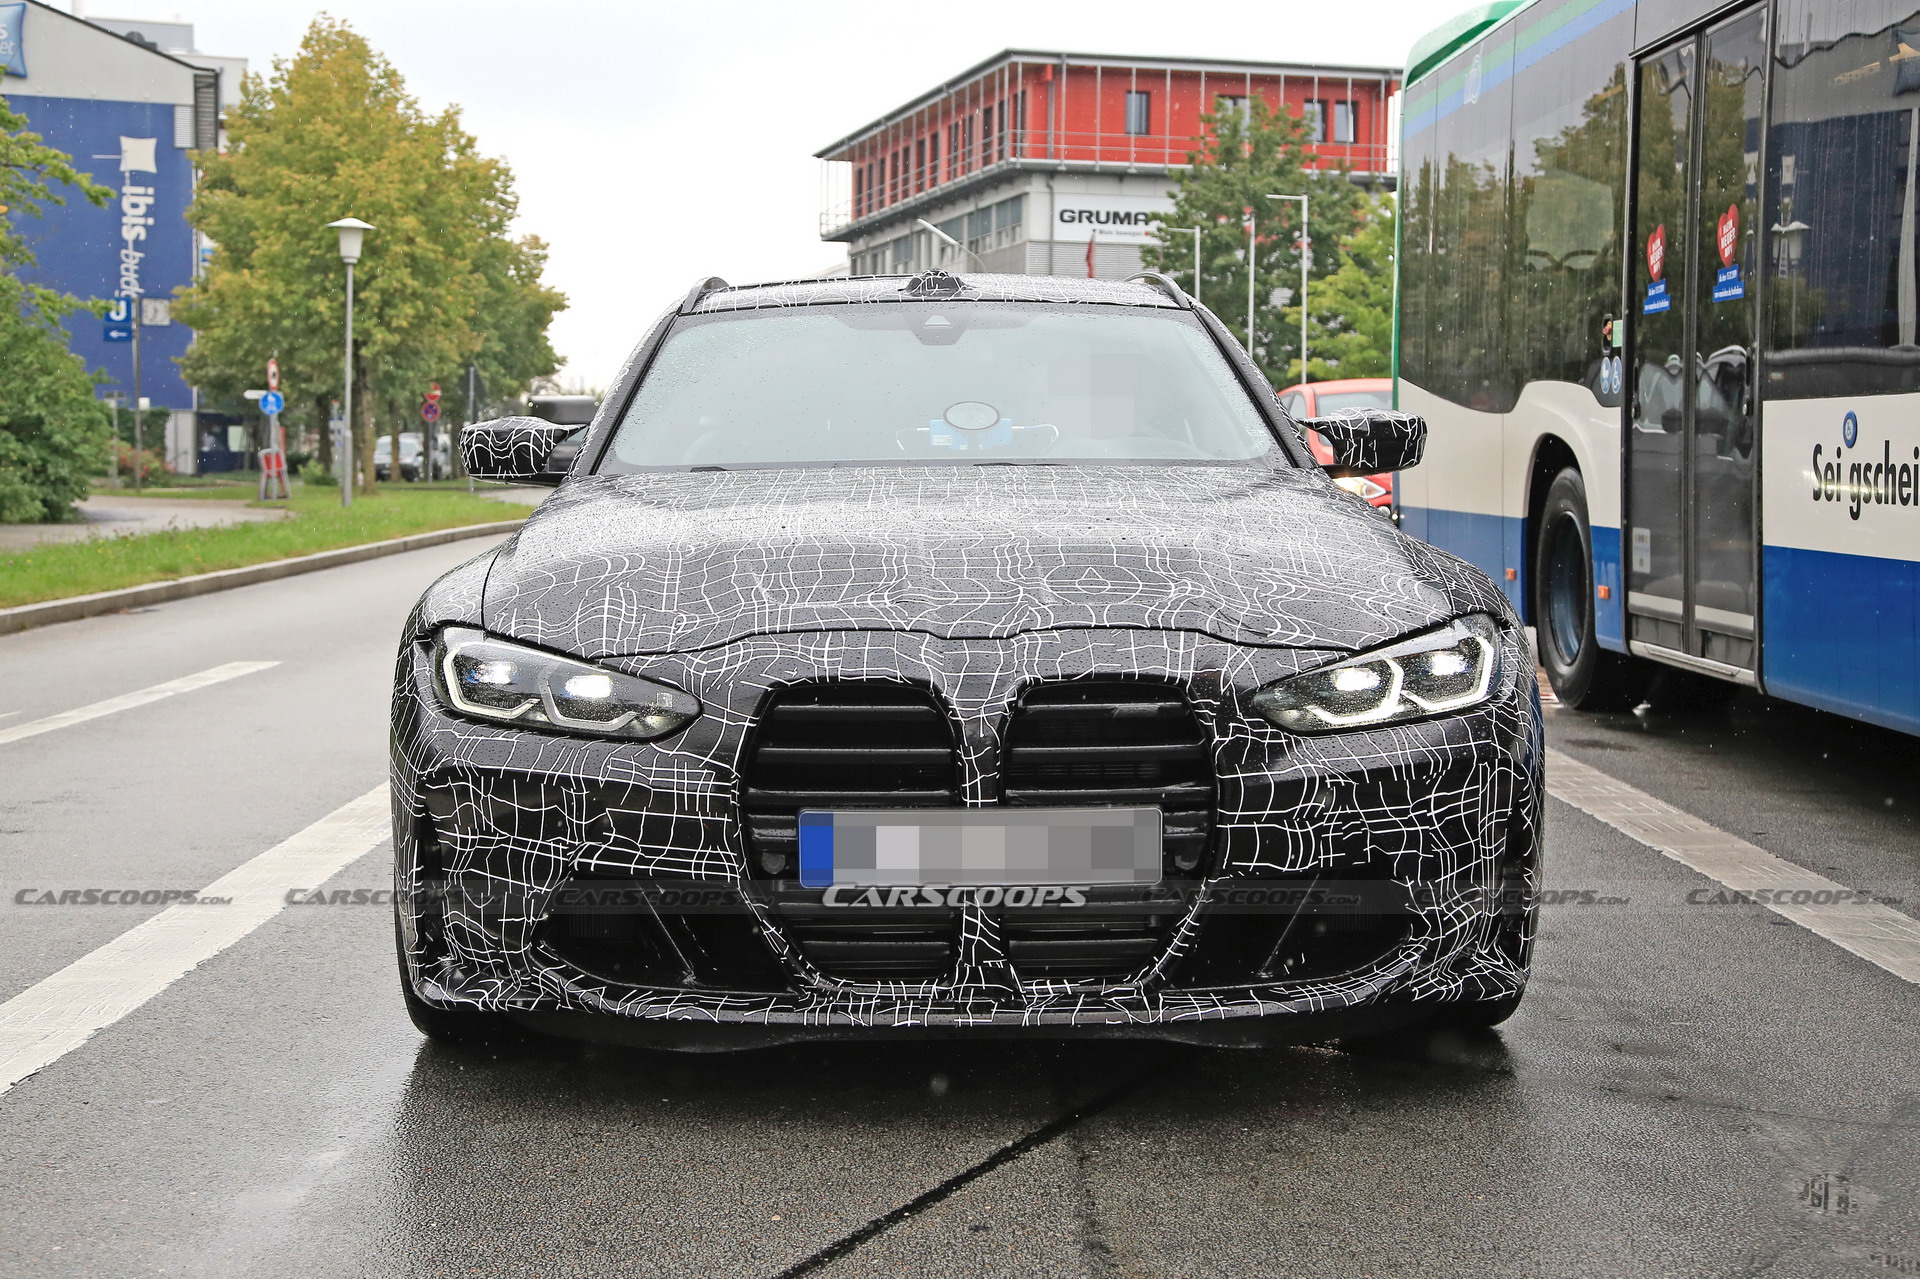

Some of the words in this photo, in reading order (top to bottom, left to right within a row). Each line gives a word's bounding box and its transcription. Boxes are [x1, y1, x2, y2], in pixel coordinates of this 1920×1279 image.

[121, 186, 155, 240] ibis
[1060, 209, 1149, 225] GRUMA
[1813, 443, 1842, 502] Sei
